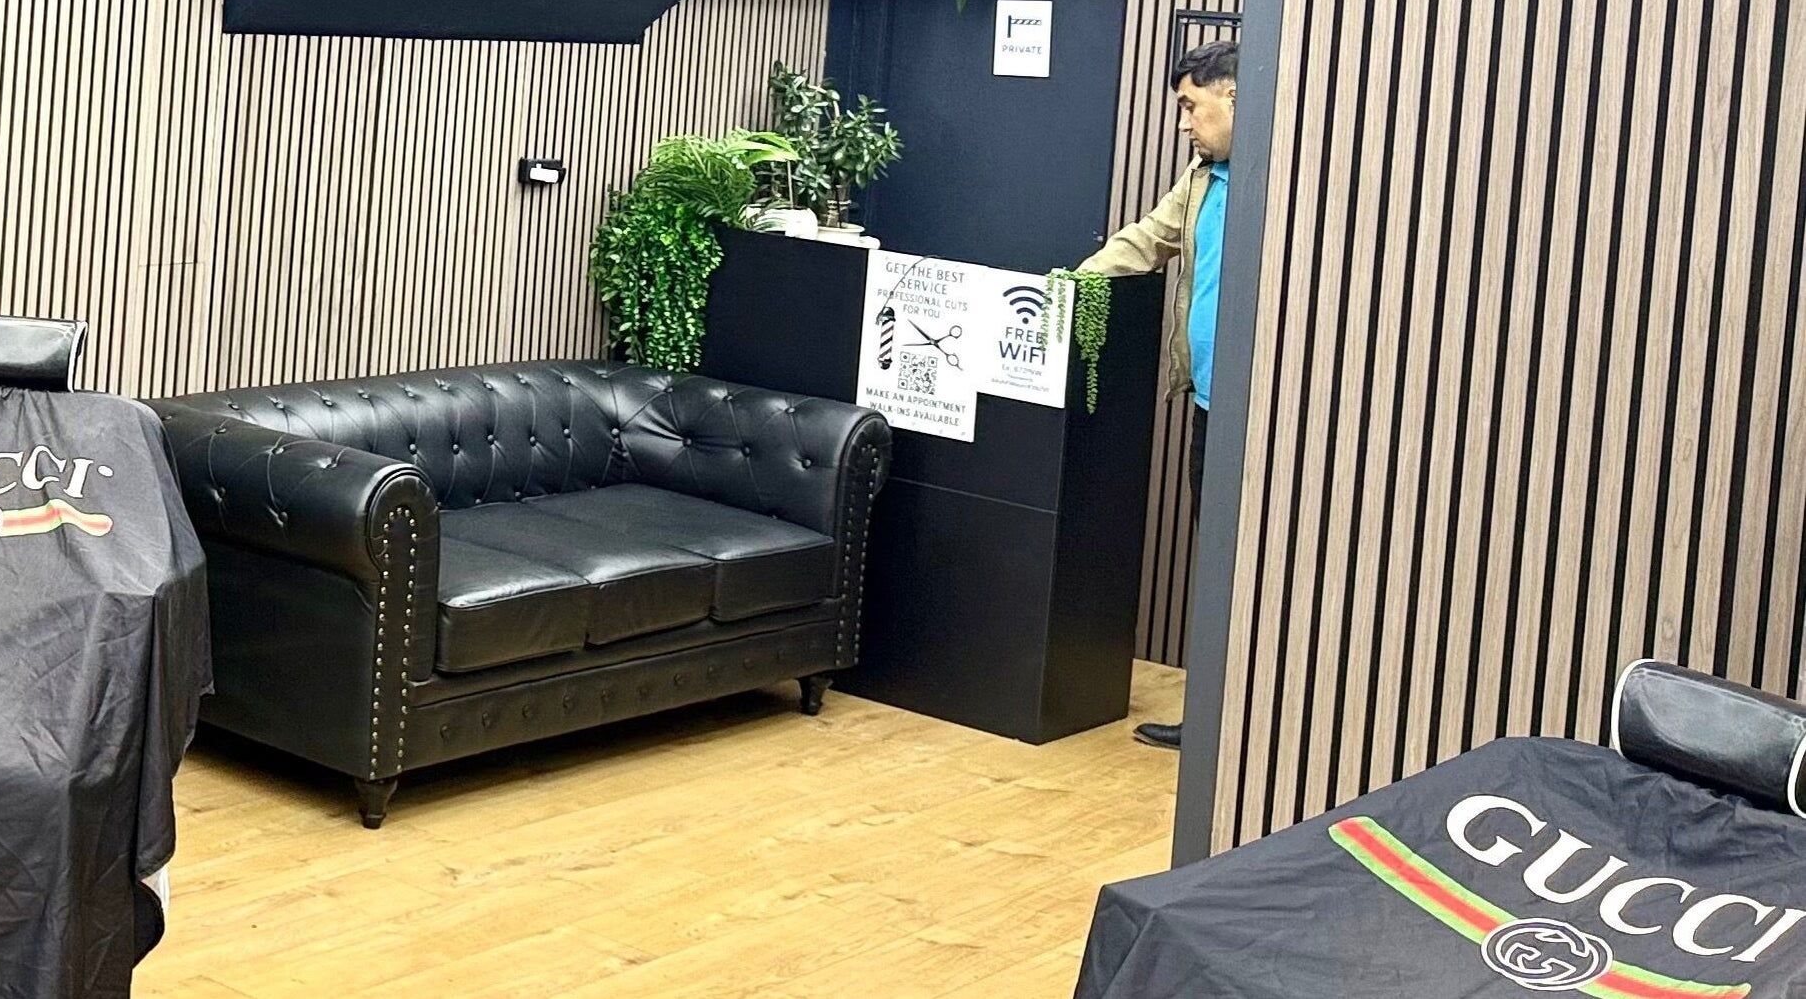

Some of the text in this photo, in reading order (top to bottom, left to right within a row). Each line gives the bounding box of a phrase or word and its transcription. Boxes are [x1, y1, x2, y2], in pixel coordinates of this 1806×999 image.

[1001, 44, 1042, 55] PRIVATE
[885, 261, 965, 284] GET THE BEST
[899, 277, 948, 295] SERVICE
[902, 303, 941, 319] FOR YOU
[944, 299, 968, 312] CUTS
[865, 387, 966, 414] MAKE AN APPOINTMENT
[913, 409, 960, 427] AVAILABLE
[1446, 793, 1806, 963] GUCCI
